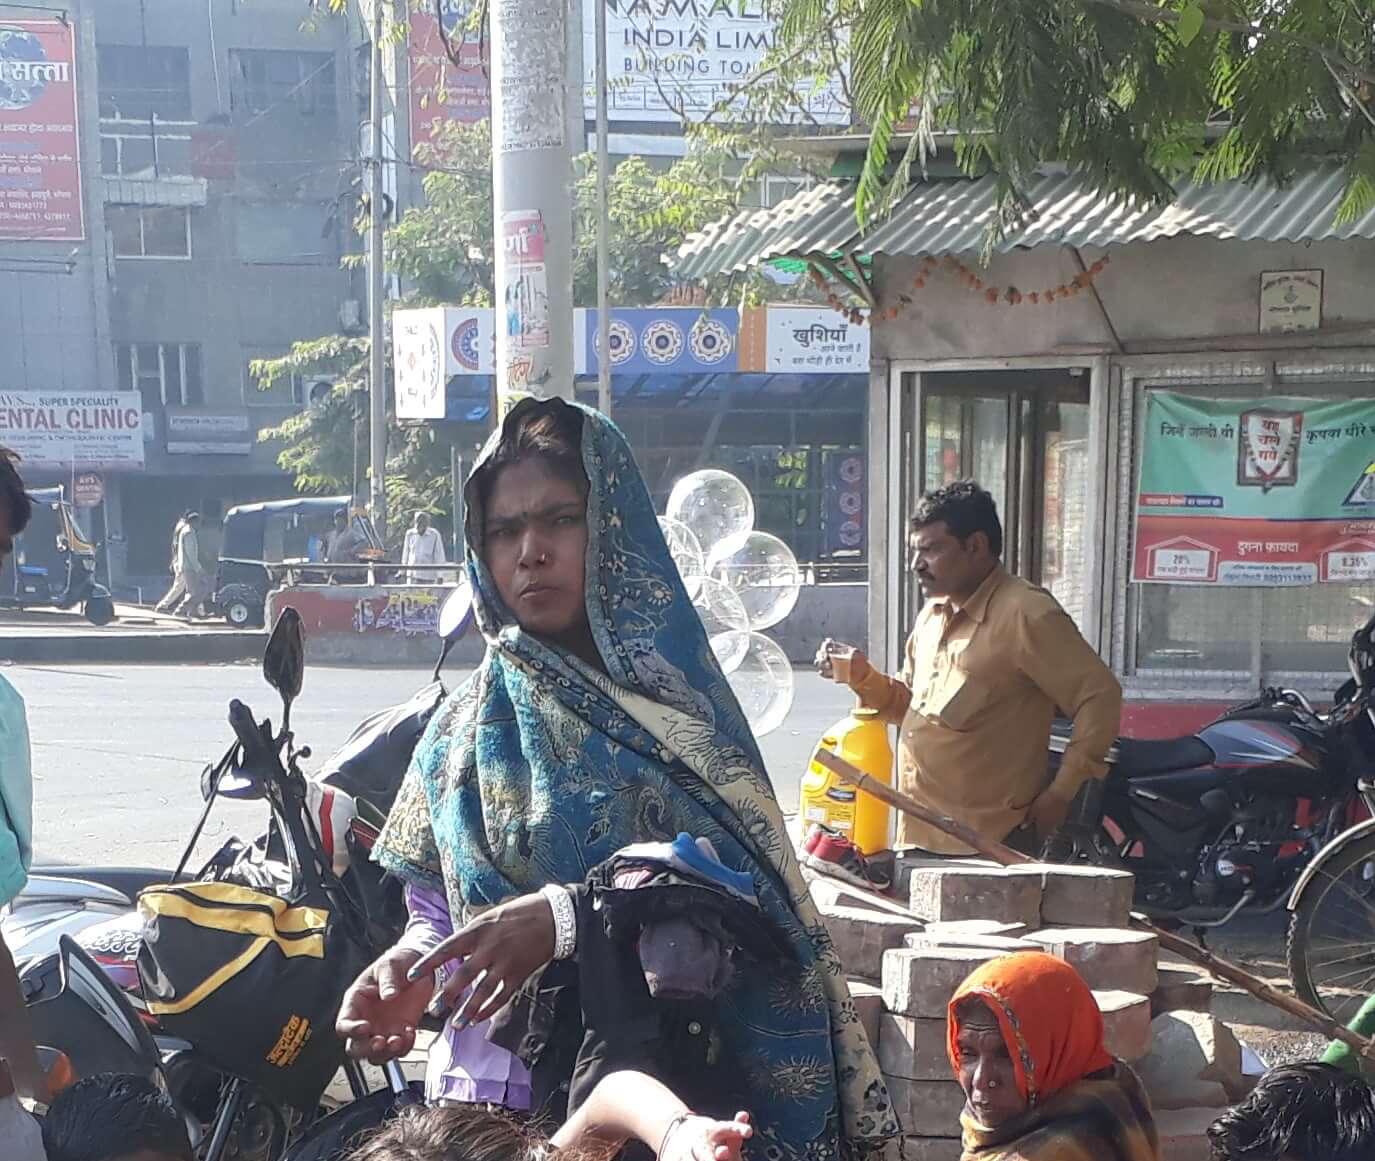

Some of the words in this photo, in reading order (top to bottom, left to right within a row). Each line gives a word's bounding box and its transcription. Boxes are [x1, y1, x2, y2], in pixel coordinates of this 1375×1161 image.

[624, 30, 706, 49] INDIA
[624, 57, 711, 75] BUILDING
[792, 324, 849, 348] खुशियाँ
[73, 407, 139, 430] CLINIC
